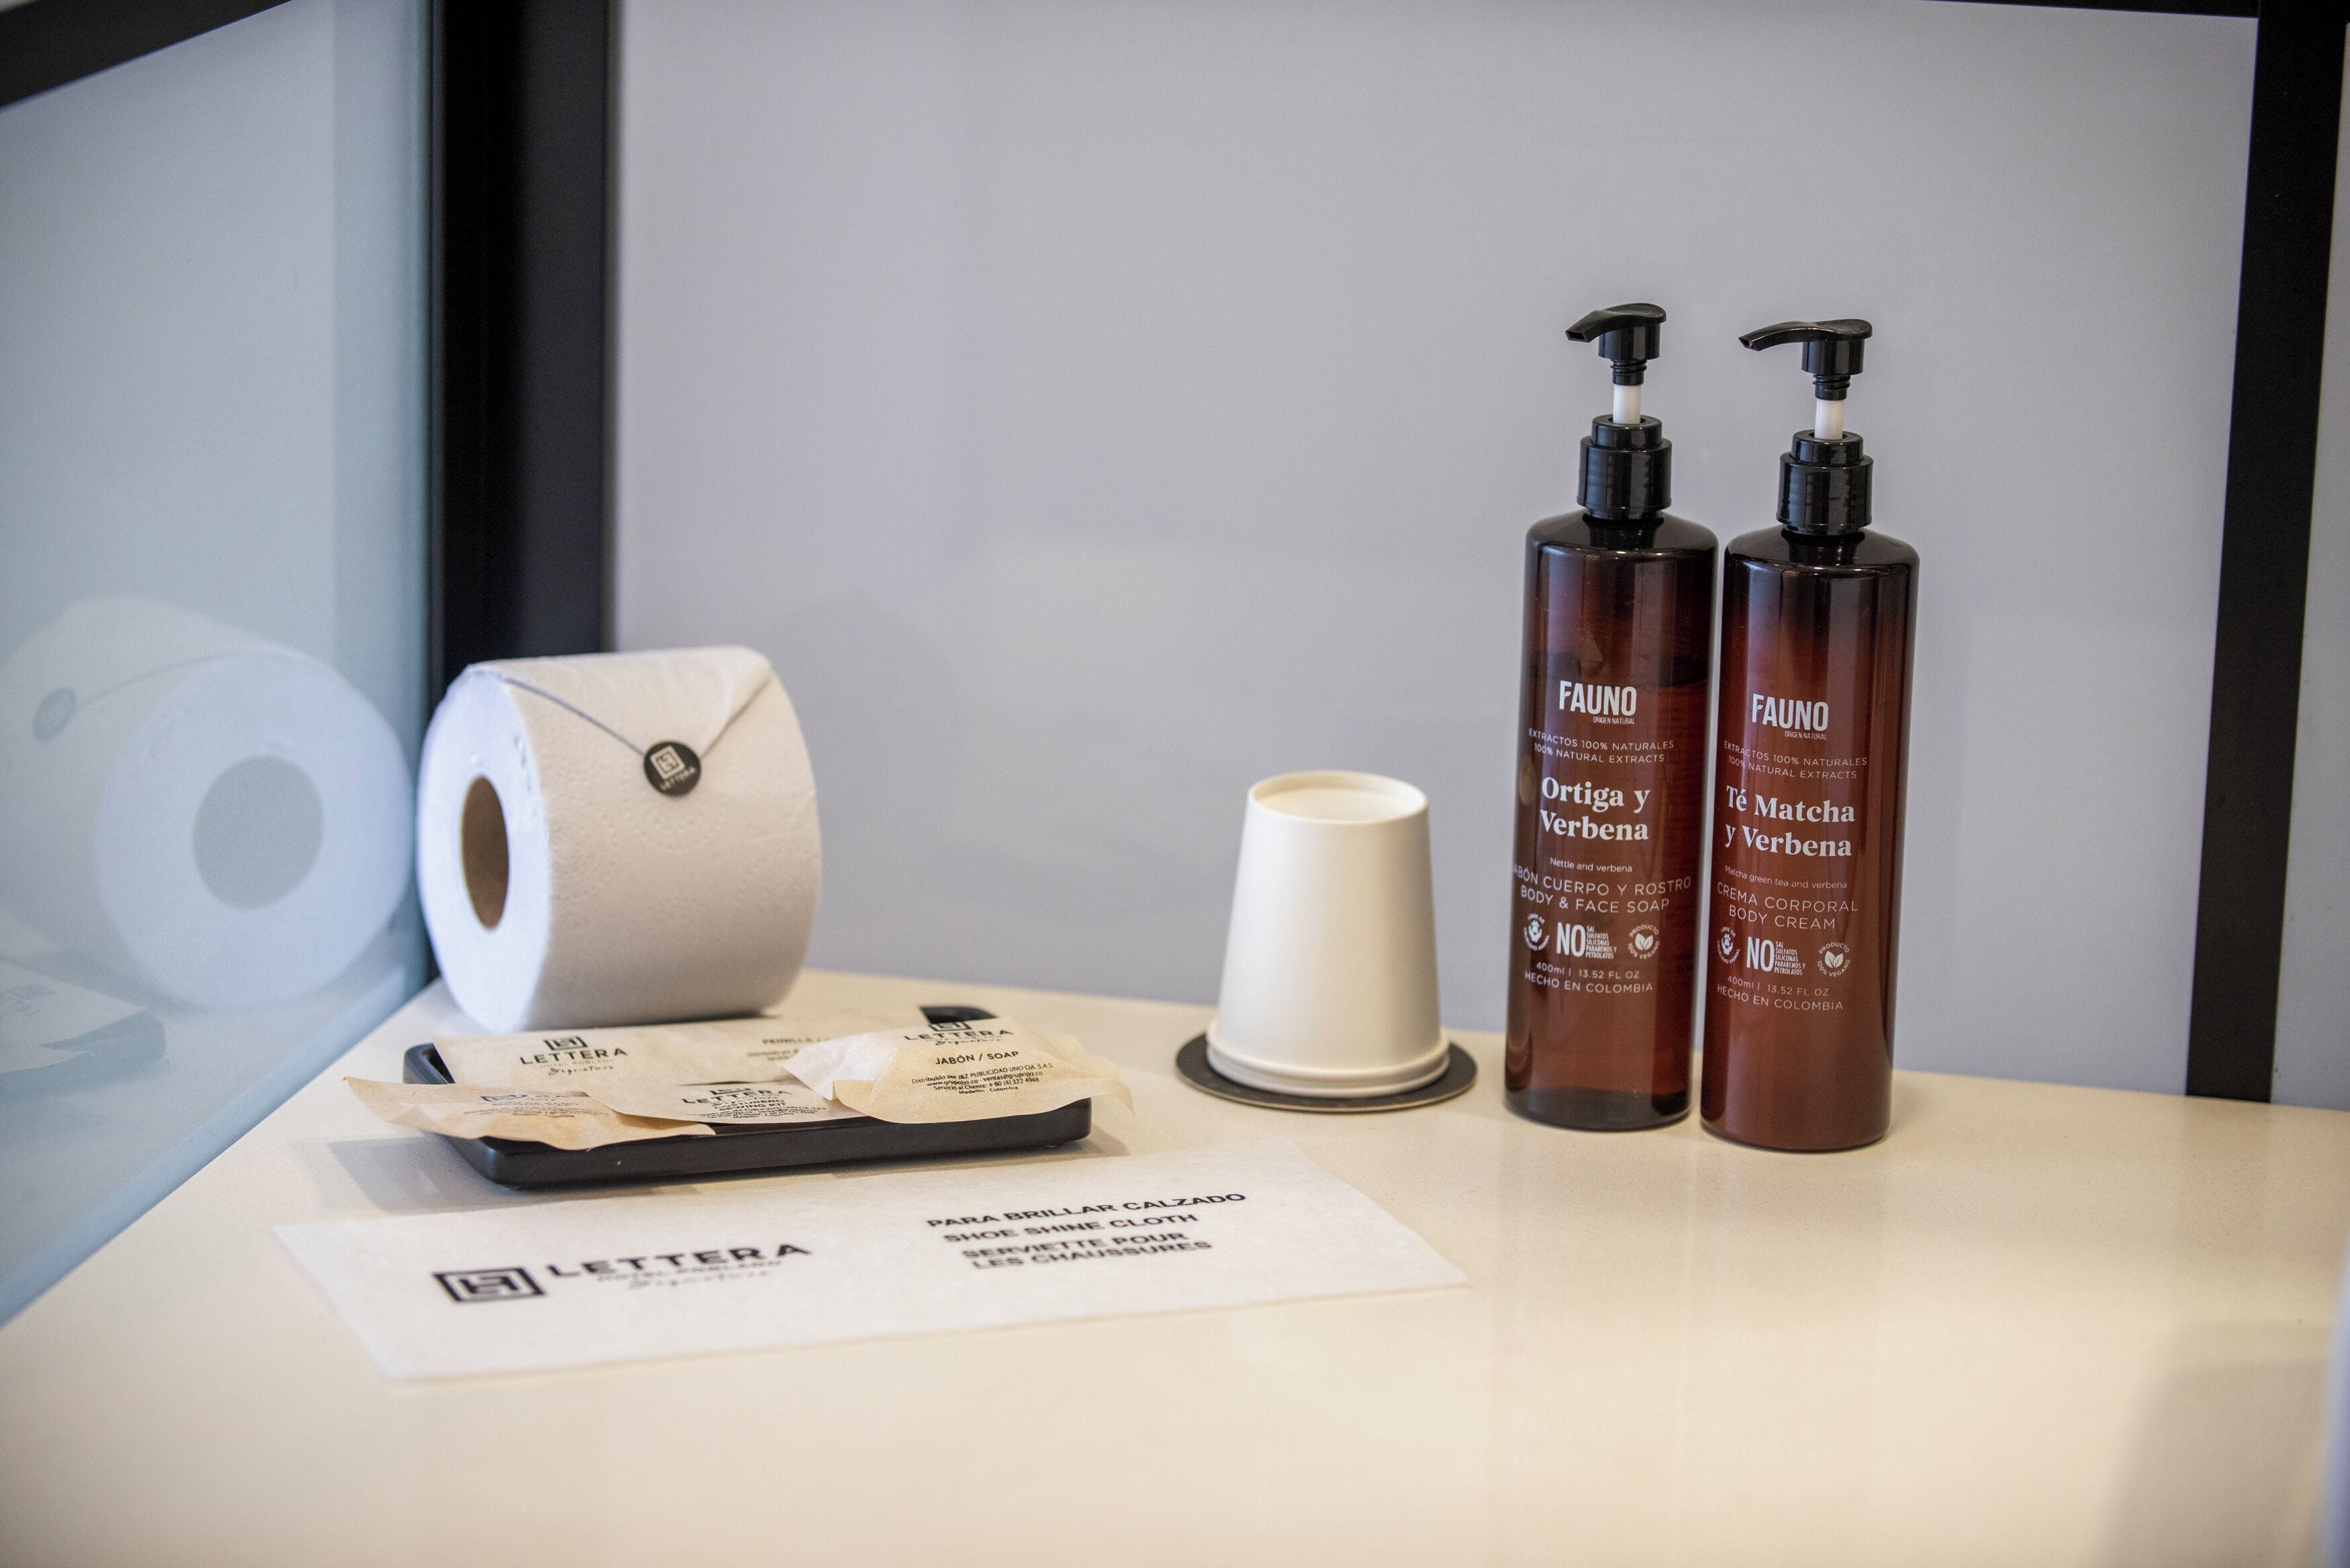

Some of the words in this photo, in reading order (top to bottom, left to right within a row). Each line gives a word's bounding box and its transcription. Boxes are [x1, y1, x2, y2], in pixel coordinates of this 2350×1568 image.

[1559, 680, 1637, 716] FAUNO
[1593, 716, 1611, 724] ORIGEN
[1752, 693, 1829, 731] FAUNO
[1529, 728, 1578, 747] EXTRACTOS
[1582, 740, 1608, 750] 100%
[1613, 740, 1675, 751] NATURALES
[1785, 730, 1802, 738] ORIGEN
[1534, 742, 1553, 756] 100%
[1556, 749, 1605, 763] NATURAL
[1609, 754, 1664, 763] EXTRACTS
[1724, 740, 1769, 761] EXTRACTOS
[1773, 754, 1799, 765] 100%
[1803, 757, 1867, 767] NATURALES
[1729, 755, 1746, 769] 100%
[1749, 763, 1795, 777] NATURAL
[1800, 771, 1857, 779] EXTRACTS
[1542, 777, 1625, 813] Ortiga
[1634, 790, 1650, 814] y
[1726, 785, 1747, 812] Té
[1754, 794, 1856, 822] Matcha
[1540, 809, 1649, 840] Verbena
[1725, 824, 1736, 848] y
[1742, 825, 1852, 856] Verbena
[1550, 858, 1574, 869] Nettle
[1577, 862, 1593, 872] and
[1597, 863, 1633, 873] verbena
[1725, 865, 1748, 879] Matcha
[1749, 874, 1773, 885] green
[1775, 878, 1789, 887] tea
[1791, 880, 1808, 889] and
[1812, 881, 1847, 889] verbena
[1544, 876, 1609, 896] CUERPO
[1617, 884, 1628, 895] Y
[1635, 876, 1691, 895] ROSTRO
[1718, 881, 1757, 905] CREMA
[1765, 896, 1859, 913] CORPORAL
[1521, 885, 1553, 905] BODY
[1559, 896, 1569, 910] &
[1576, 899, 1619, 914] FACE
[1627, 898, 1669, 914] SOAP
[1729, 905, 1767, 924] BODY
[1775, 916, 1835, 930] CREAM
[1556, 922, 1586, 957] NO
[1630, 924, 1659, 937] PRODUCTO
[1747, 936, 1775, 972] NO
[1775, 948, 1797, 956] SULFATOS
[1819, 942, 1850, 954] PRODUCTO
[1537, 962, 1564, 974] 400ml
[1579, 969, 1604, 979] 13.52
[1609, 971, 1621, 979] FL
[1626, 971, 1640, 979] OZ
[1829, 959, 1850, 977] VEGANO
[1525, 971, 1560, 988] HECHO
[1564, 980, 1581, 991] EN
[1586, 983, 1653, 993] COLOMBIA
[1728, 975, 1754, 989] 400ml
[1767, 985, 1793, 995] 13.52
[1797, 988, 1809, 996] FL
[1814, 988, 1829, 997] OZ
[1718, 983, 1749, 1002] HECHO
[1754, 995, 1769, 1006] EN
[1775, 999, 1843, 1010] COLOMBIA
[904, 1030, 1015, 1040] LETTERA
[520, 1048, 628, 1065] LETTERA
[935, 1055, 975, 1065] JABÓN
[987, 1051, 1019, 1059] SOAP
[970, 1067, 1008, 1078] PUBLICIDAD
[682, 1090, 792, 1104] LETTERA
[927, 1214, 1000, 1228] PARA
[1004, 1204, 1113, 1221] BRILLAR
[1123, 1193, 1246, 1211] CALZADO
[943, 1228, 1019, 1243] SHOE
[1025, 1221, 1104, 1236] SHINE
[1109, 1213, 1198, 1228] CLOTH
[962, 1238, 1107, 1259] SERVIETTE
[1112, 1232, 1189, 1246] POUR
[972, 1256, 1025, 1269] LES
[1031, 1240, 1212, 1265] CHAUSSURES
[547, 1243, 812, 1279] LETTERA
